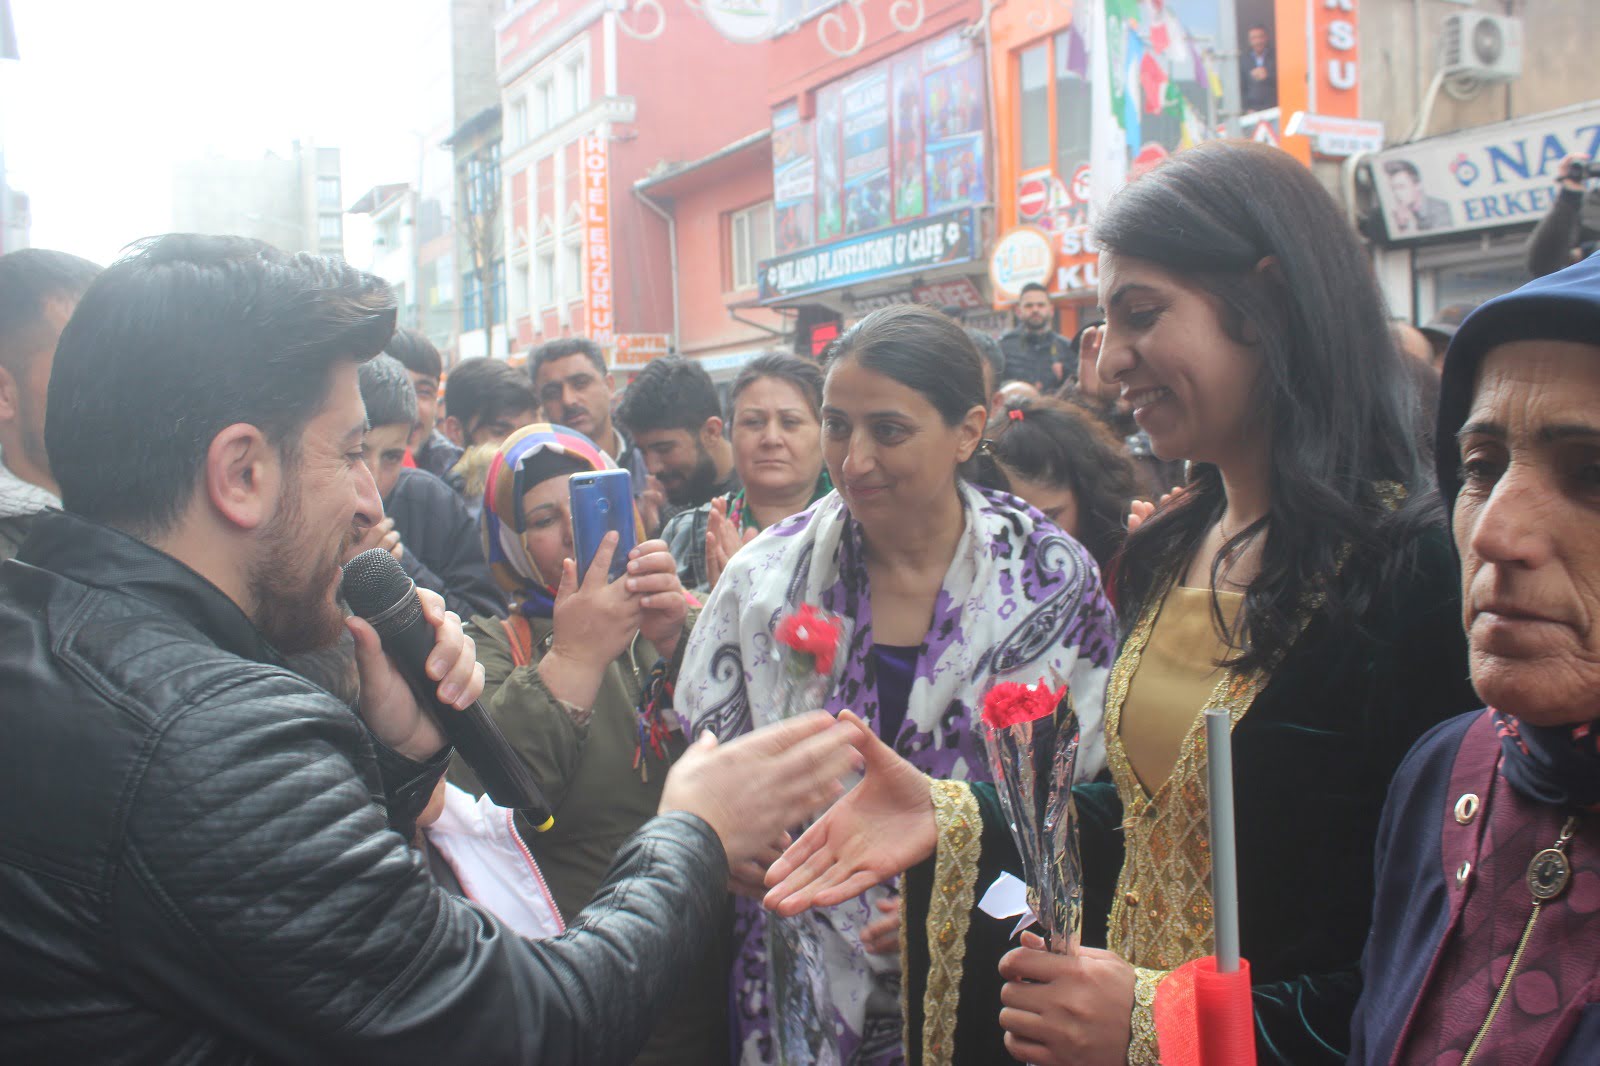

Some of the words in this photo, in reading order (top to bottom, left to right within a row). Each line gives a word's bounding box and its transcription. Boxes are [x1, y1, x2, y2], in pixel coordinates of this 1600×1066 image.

[586, 136, 606, 223] HOTEL
[589, 227, 611, 343] ERZURUM
[776, 255, 818, 290] MILANO
[908, 223, 944, 261] CAFE
